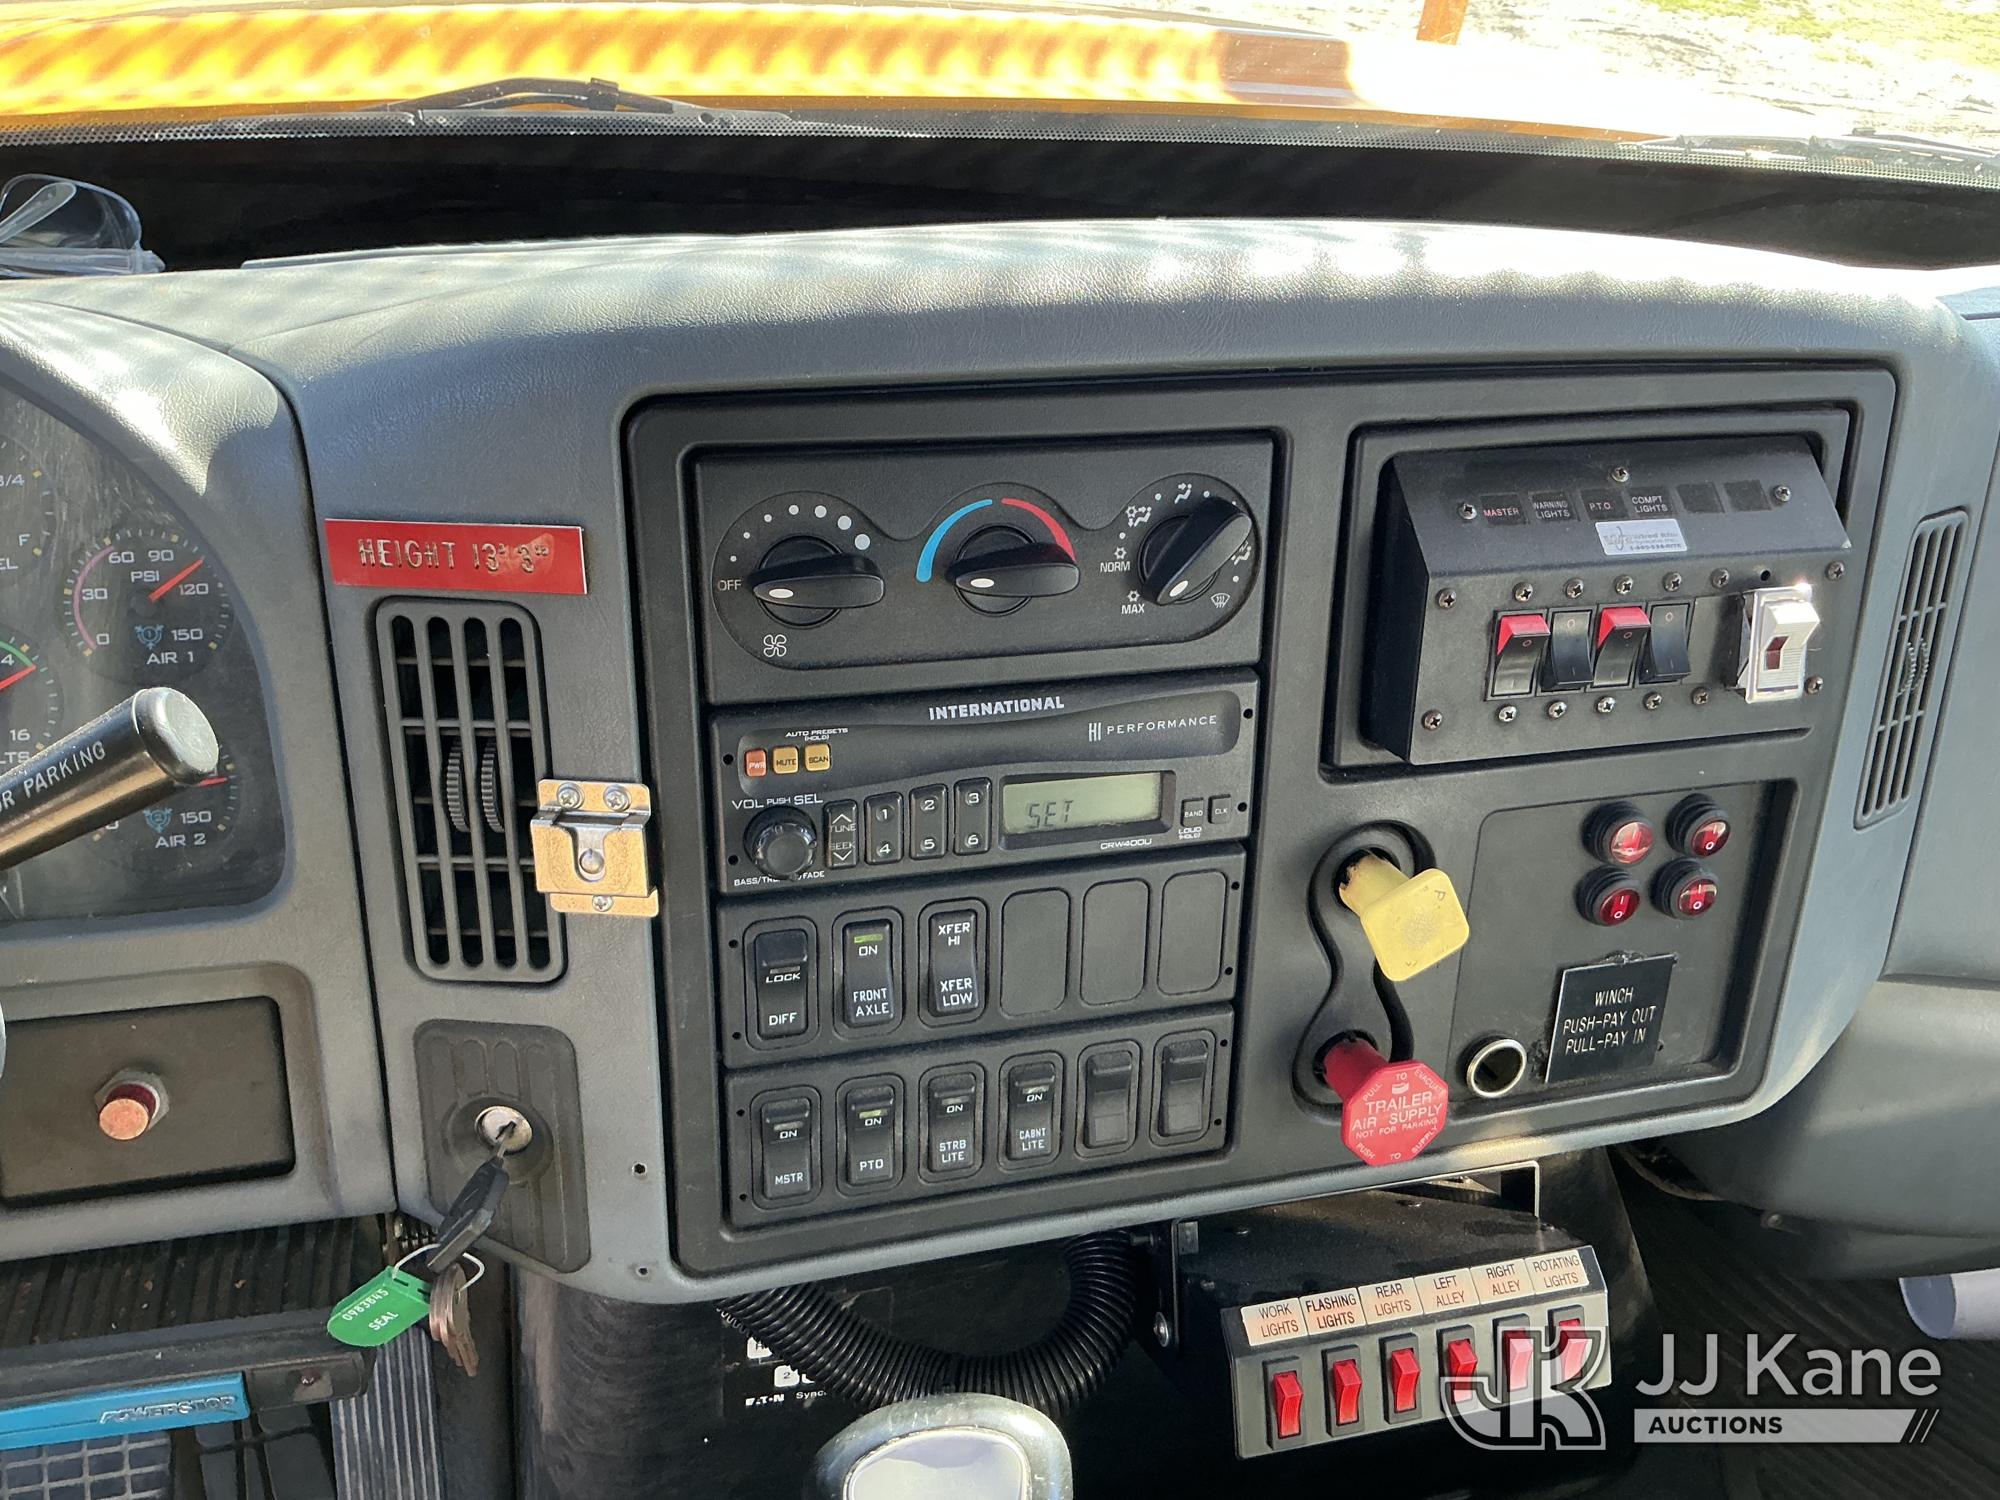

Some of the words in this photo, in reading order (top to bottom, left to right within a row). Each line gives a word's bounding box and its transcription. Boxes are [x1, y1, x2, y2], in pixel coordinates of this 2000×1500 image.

[1532, 500, 1568, 510] WARNING
[1631, 495, 1663, 505] COMPT
[1483, 507, 1520, 517] MASTER
[1535, 509, 1570, 518] LIGHTS
[1634, 503, 1668, 513] LIGHTS
[18, 533, 31, 547] F
[108, 553, 135, 564] 60
[148, 550, 174, 562] 90
[358, 539, 455, 568] HEIGHT
[1100, 561, 1131, 573] NORM
[131, 570, 160, 583] PSI
[82, 588, 108, 600] 30
[179, 583, 209, 596] 120
[717, 579, 742, 591] OFF
[1121, 603, 1145, 615] MAX
[96, 633, 110, 646] 0
[171, 628, 203, 641] 150
[146, 652, 178, 665] AIR
[188, 651, 194, 663] 1
[929, 696, 1065, 720] INTERNATIONAL
[9, 728, 31, 741] 16
[785, 729, 810, 738] AUTO
[811, 727, 849, 735] PRESETS
[1088, 722, 1102, 742] HI
[1107, 714, 1218, 736] PERFORMANCE
[776, 759, 797, 767] MUTE
[808, 756, 829, 764] SCAN
[23, 741, 107, 799] PARKING
[731, 799, 765, 811] VOL
[793, 793, 824, 806] SEL
[923, 799, 936, 811] 2
[967, 792, 981, 804] 3
[180, 811, 213, 824] 150
[881, 809, 889, 820] 1
[1025, 800, 1075, 830] SET
[1184, 810, 1204, 818] BAND
[1214, 807, 1229, 815] CLK
[829, 823, 857, 833] TUNE
[1178, 826, 1203, 835] LOUD
[154, 835, 187, 849] AIR
[193, 833, 207, 847] 2
[923, 838, 936, 850] 5
[967, 833, 980, 846] 6
[829, 842, 857, 852] SEEK
[878, 843, 893, 855] 4
[937, 922, 972, 936] XFER
[947, 935, 961, 947] HI
[858, 945, 878, 958] ON
[765, 972, 801, 984] LOCK
[939, 977, 973, 993] XFER
[852, 987, 887, 1003] FRONT
[942, 991, 973, 1008] LOW
[1594, 986, 1634, 1007] WINCH
[855, 1001, 890, 1018] AXLE
[768, 1012, 798, 1027] DIFF
[1562, 1010, 1628, 1036] PUSH-PAY
[1631, 1005, 1657, 1025] OUT
[1564, 1030, 1629, 1055] PULL-PAY
[1632, 1027, 1647, 1045] IN
[1362, 1082, 1383, 1102] PULL
[1395, 1071, 1408, 1081] TO
[1413, 1068, 1447, 1097] EVACUATE
[1026, 1093, 1044, 1103] ON
[1365, 1090, 1433, 1115] TRAILER
[946, 1104, 964, 1114] ON
[864, 1117, 883, 1127] ON
[1351, 1116, 1377, 1132] AIR
[1388, 1103, 1443, 1125] SUPPLY
[779, 1129, 798, 1140] ON
[1018, 1127, 1047, 1141] CABNT
[1355, 1129, 1374, 1140] NOT
[1378, 1125, 1397, 1136] FOR
[1401, 1117, 1438, 1131] PARKING
[938, 1139, 967, 1152] STRB
[1021, 1139, 1046, 1151] LITE
[1355, 1141, 1376, 1160] PUSH
[1389, 1151, 1402, 1161] TO
[1411, 1125, 1438, 1154] SUPPLY
[941, 1151, 966, 1163] LITE
[859, 1158, 884, 1172] PTO
[774, 1171, 804, 1186] MSTR
[1532, 1254, 1581, 1274] ROTATING
[1486, 1263, 1516, 1280] RIGHT
[1432, 1275, 1458, 1291] LEFT
[1492, 1279, 1522, 1297] ALLEY
[1543, 1273, 1580, 1290] LIGHTS
[1375, 1282, 1405, 1299] REAR
[1305, 1293, 1358, 1313] FLASHING
[1436, 1291, 1466, 1308] ALLEY
[1258, 1303, 1293, 1320] WORK
[1375, 1299, 1413, 1317] LIGHTS
[368, 1311, 400, 1331] SEAL
[1317, 1312, 1356, 1330] LIGHTS
[1260, 1319, 1300, 1338] LIGHTS
[783, 1372, 791, 1380] 2
[99, 1396, 237, 1425] POWERSTOP
